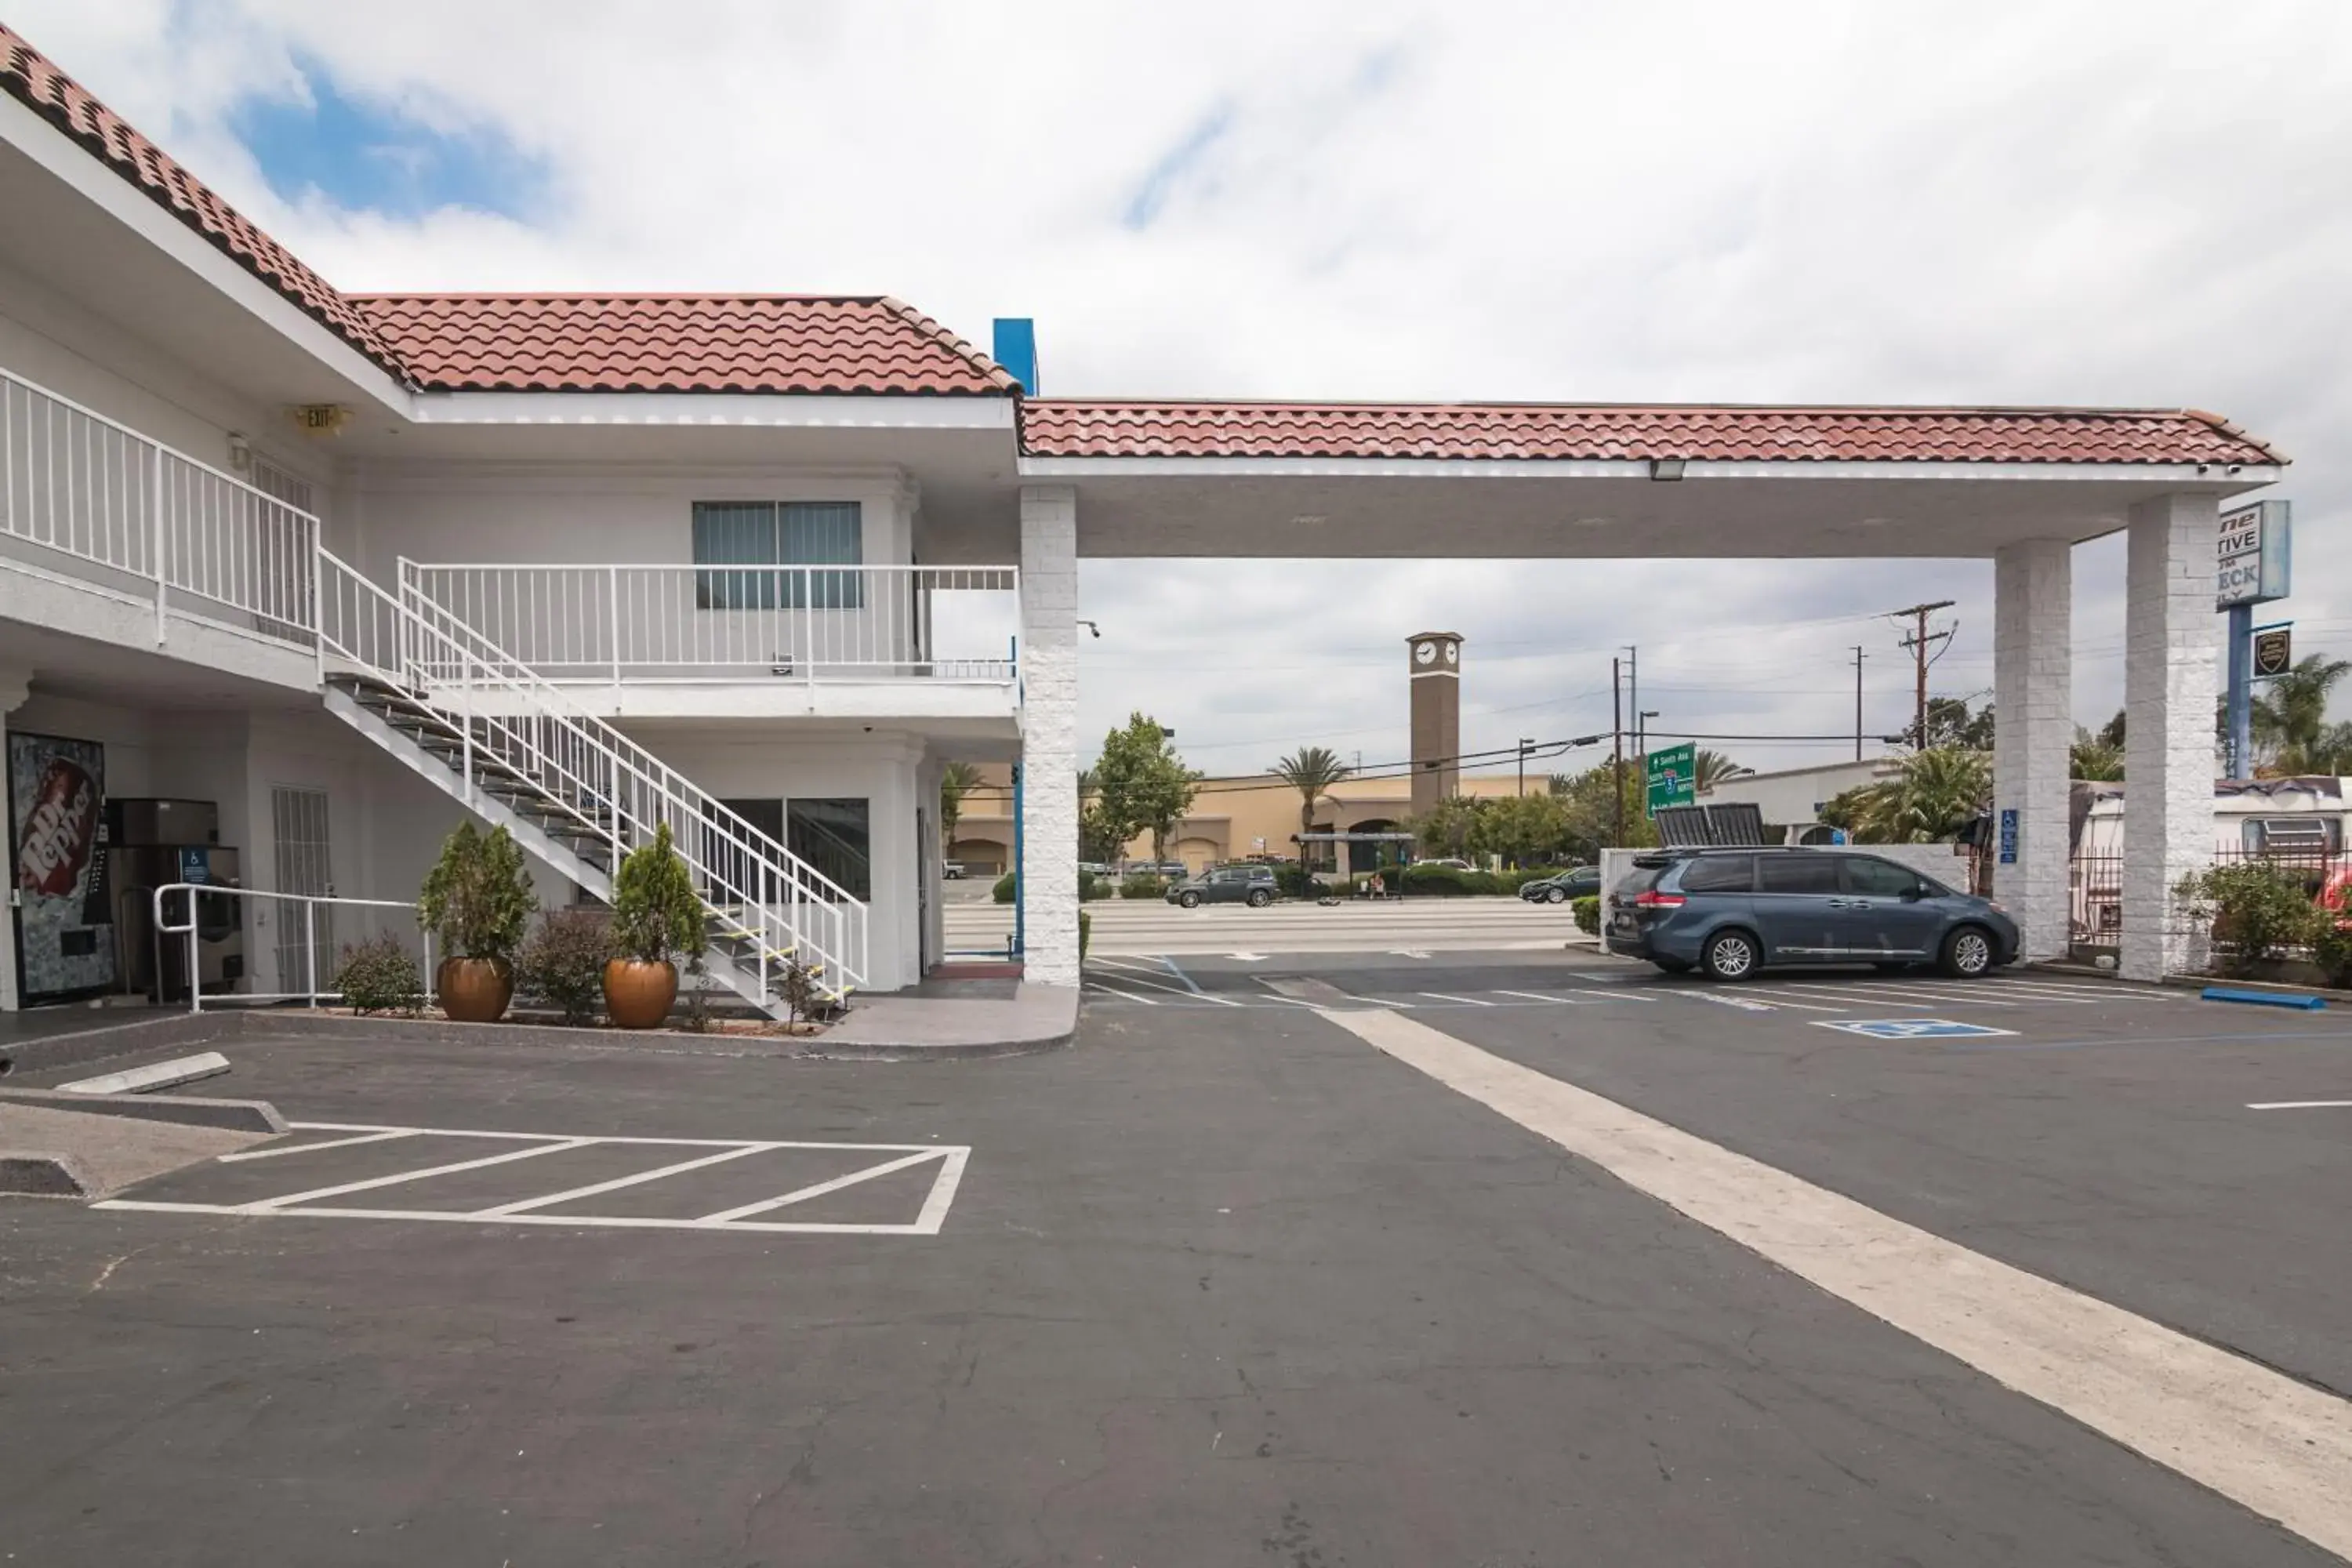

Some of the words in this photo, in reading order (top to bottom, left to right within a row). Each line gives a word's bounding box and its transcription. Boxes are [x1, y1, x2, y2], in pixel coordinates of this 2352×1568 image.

[308, 408, 329, 427] EXIT
[2218, 564, 2256, 590] ECK
[34, 792, 66, 840] Dr
